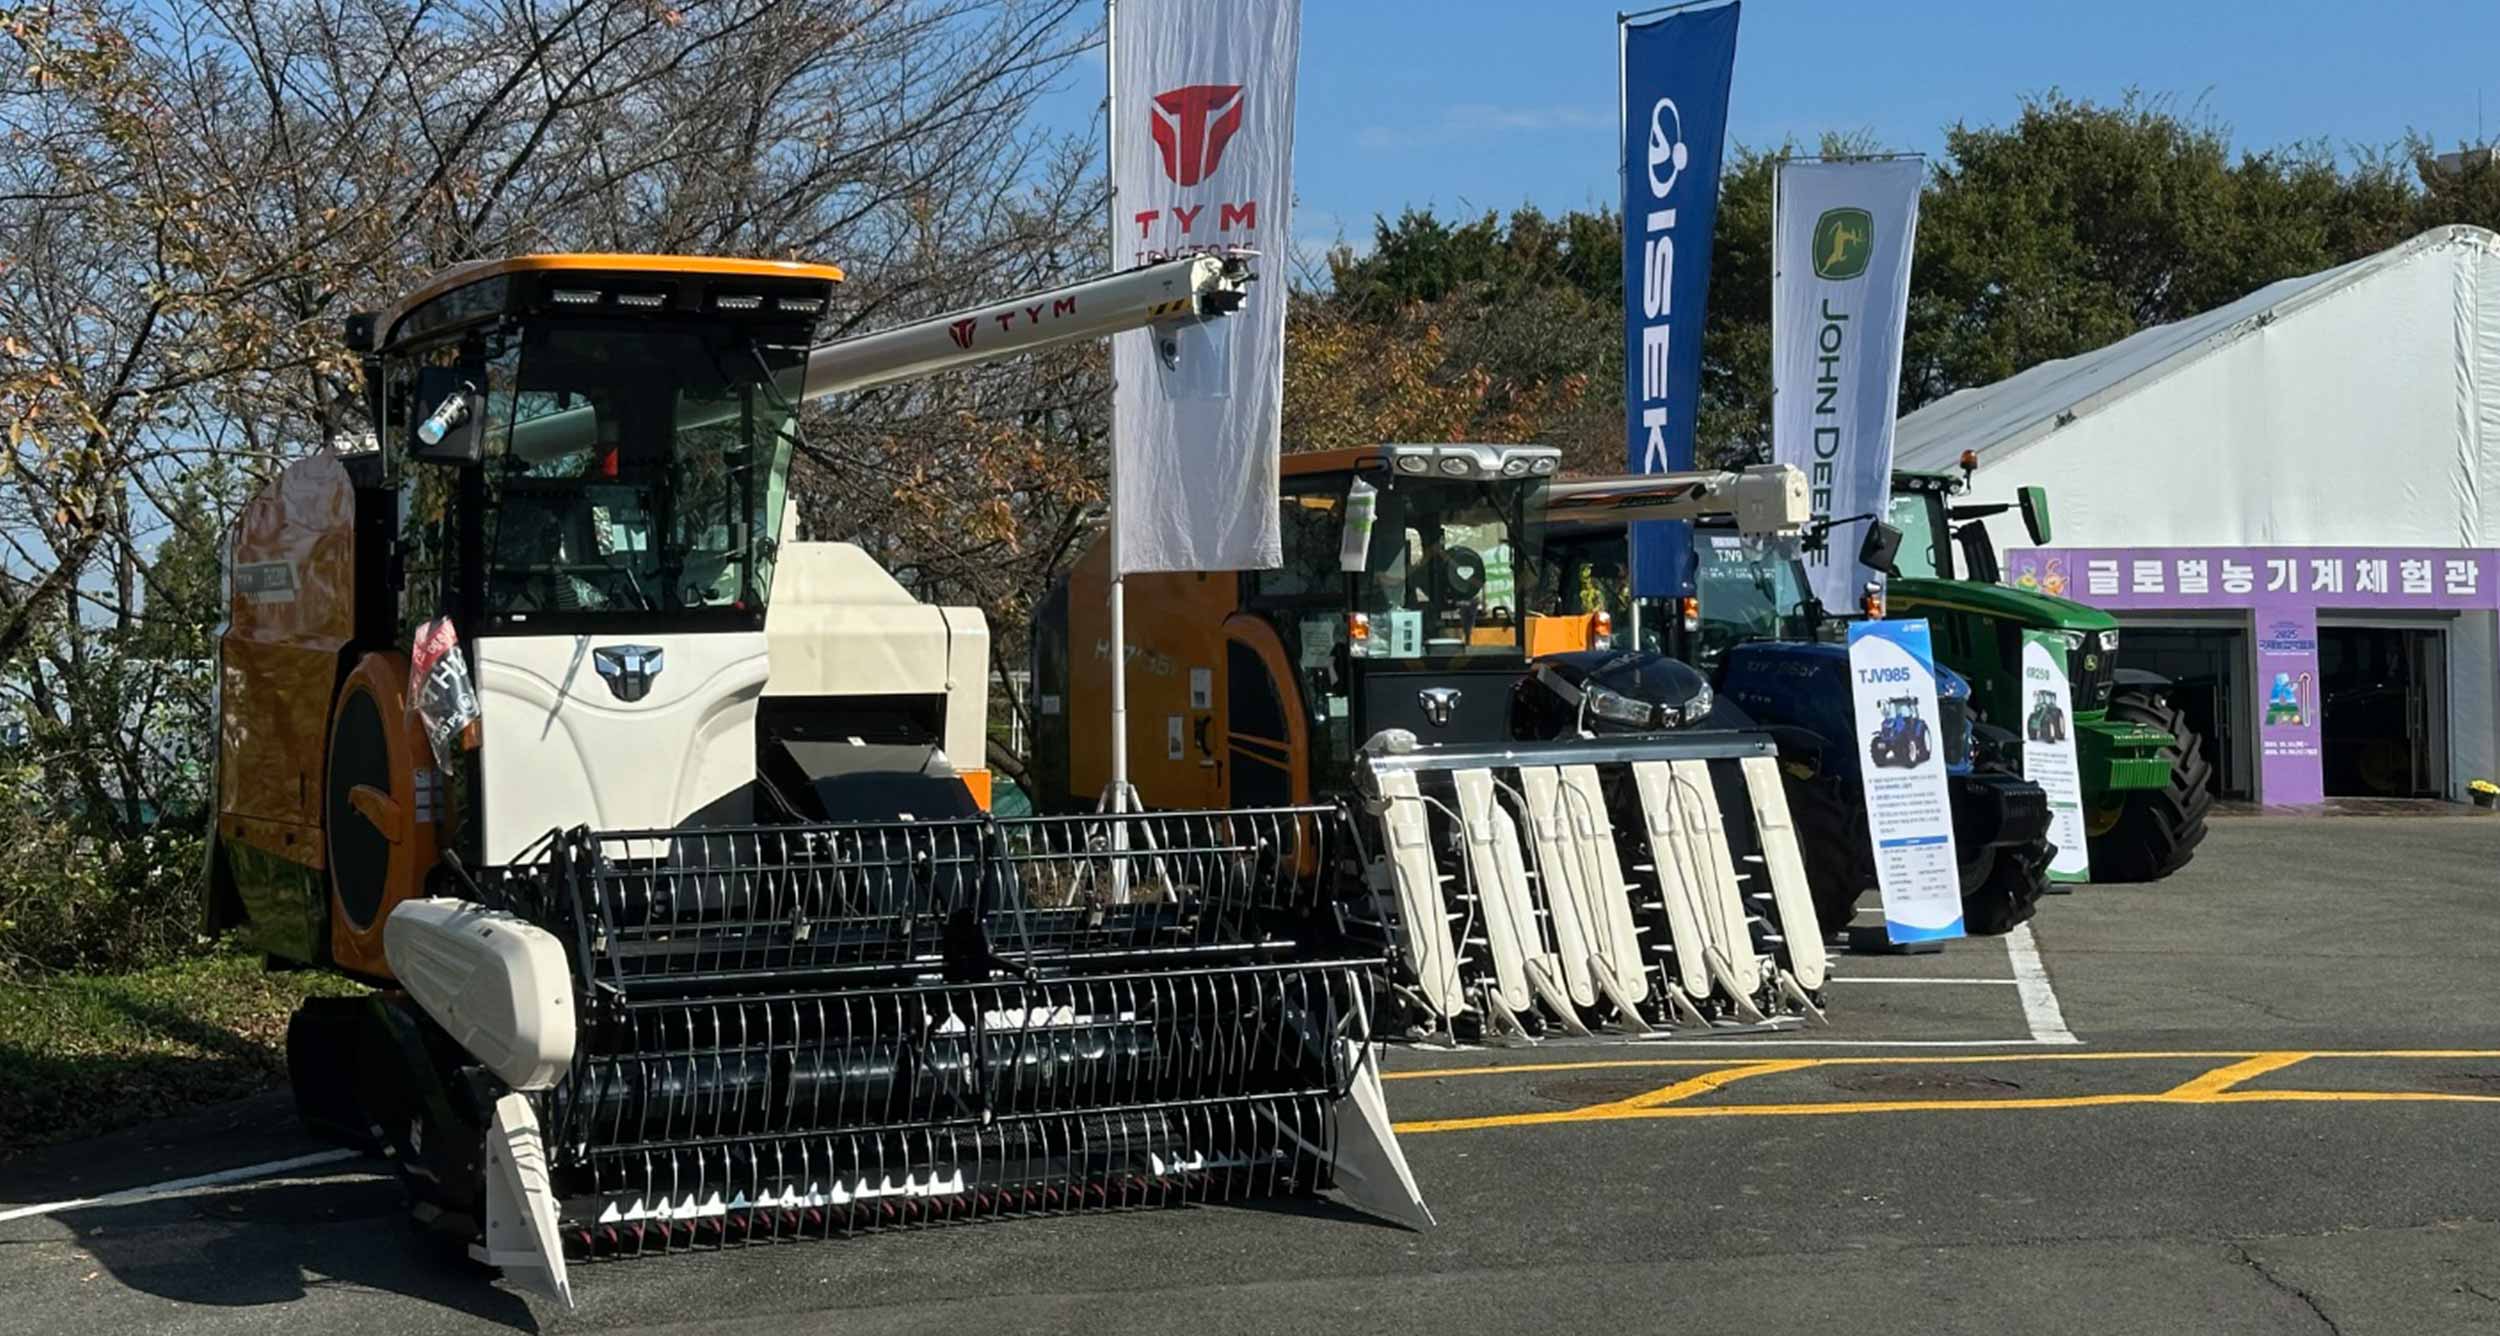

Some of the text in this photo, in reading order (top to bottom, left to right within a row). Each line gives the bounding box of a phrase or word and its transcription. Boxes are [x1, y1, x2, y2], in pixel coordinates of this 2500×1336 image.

[1135, 201, 1256, 239] TYM
[995, 295, 1077, 333] TYM
[1643, 208, 1677, 475] ISEK
[1815, 298, 1849, 415] JOHN
[1715, 548, 1744, 563] TJV9
[1858, 666, 1911, 684] TJV985
